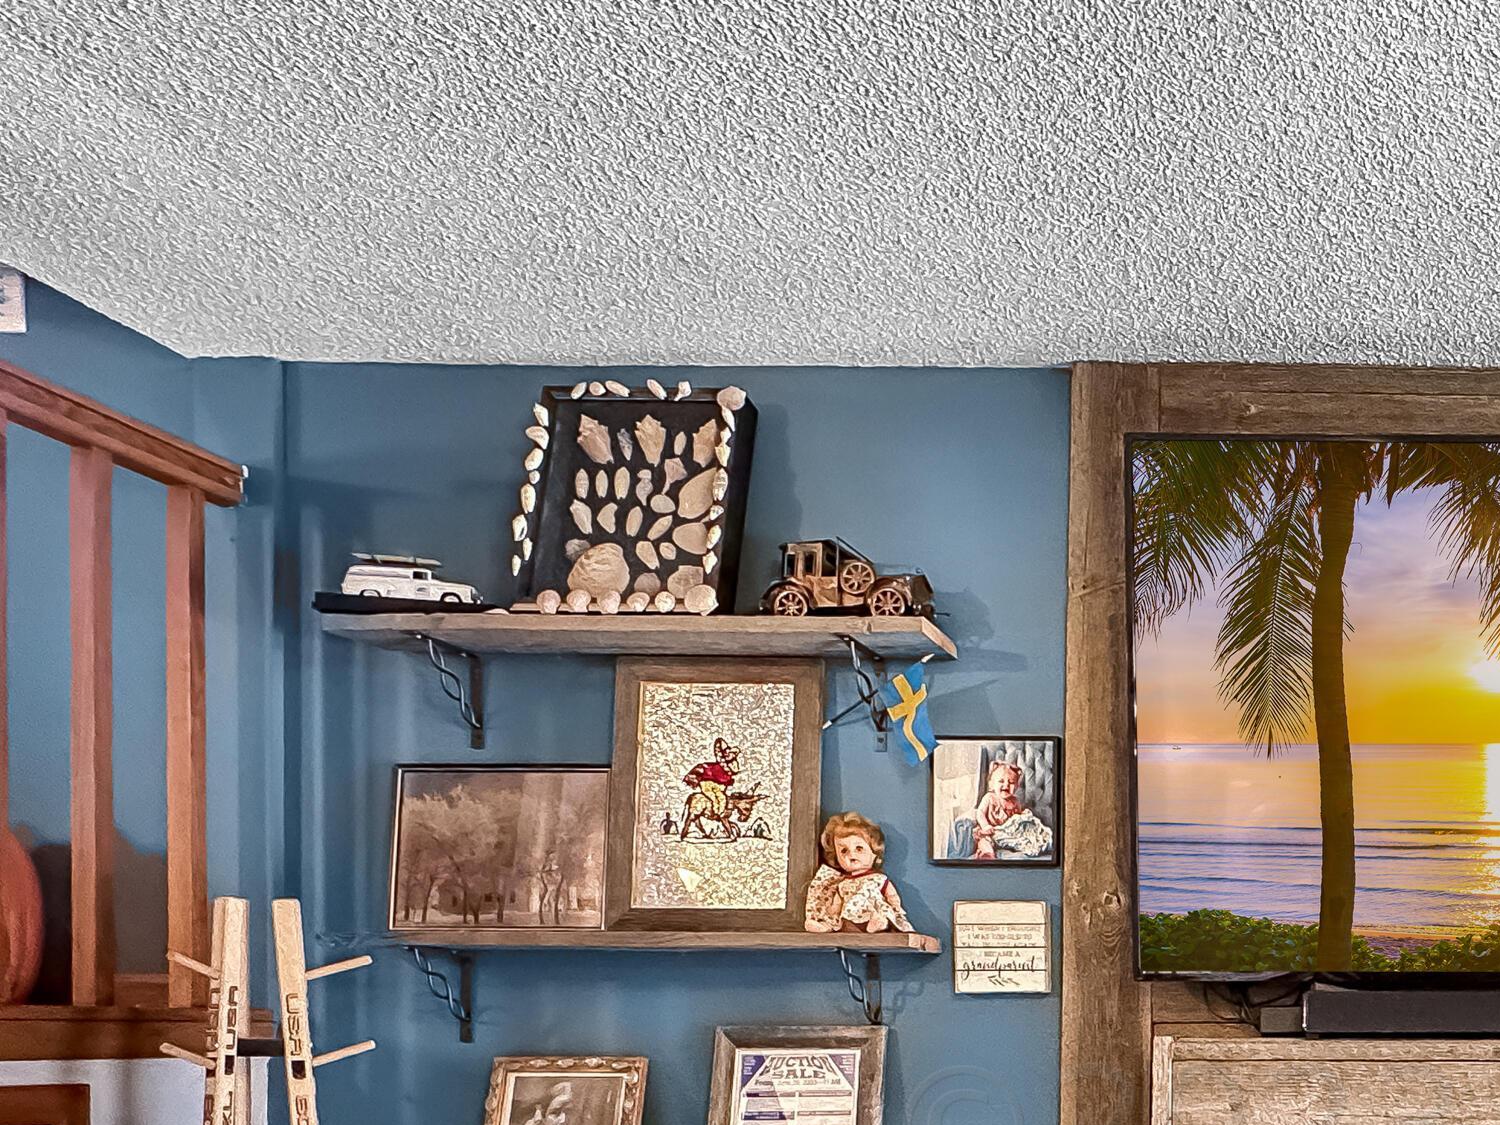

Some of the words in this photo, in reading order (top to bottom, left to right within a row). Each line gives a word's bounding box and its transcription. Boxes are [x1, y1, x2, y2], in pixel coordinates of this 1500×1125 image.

[226, 985, 238, 1050] USA
[286, 992, 302, 1056] USA
[759, 1055, 839, 1077] AUCTION
[771, 1068, 827, 1080] SALE
